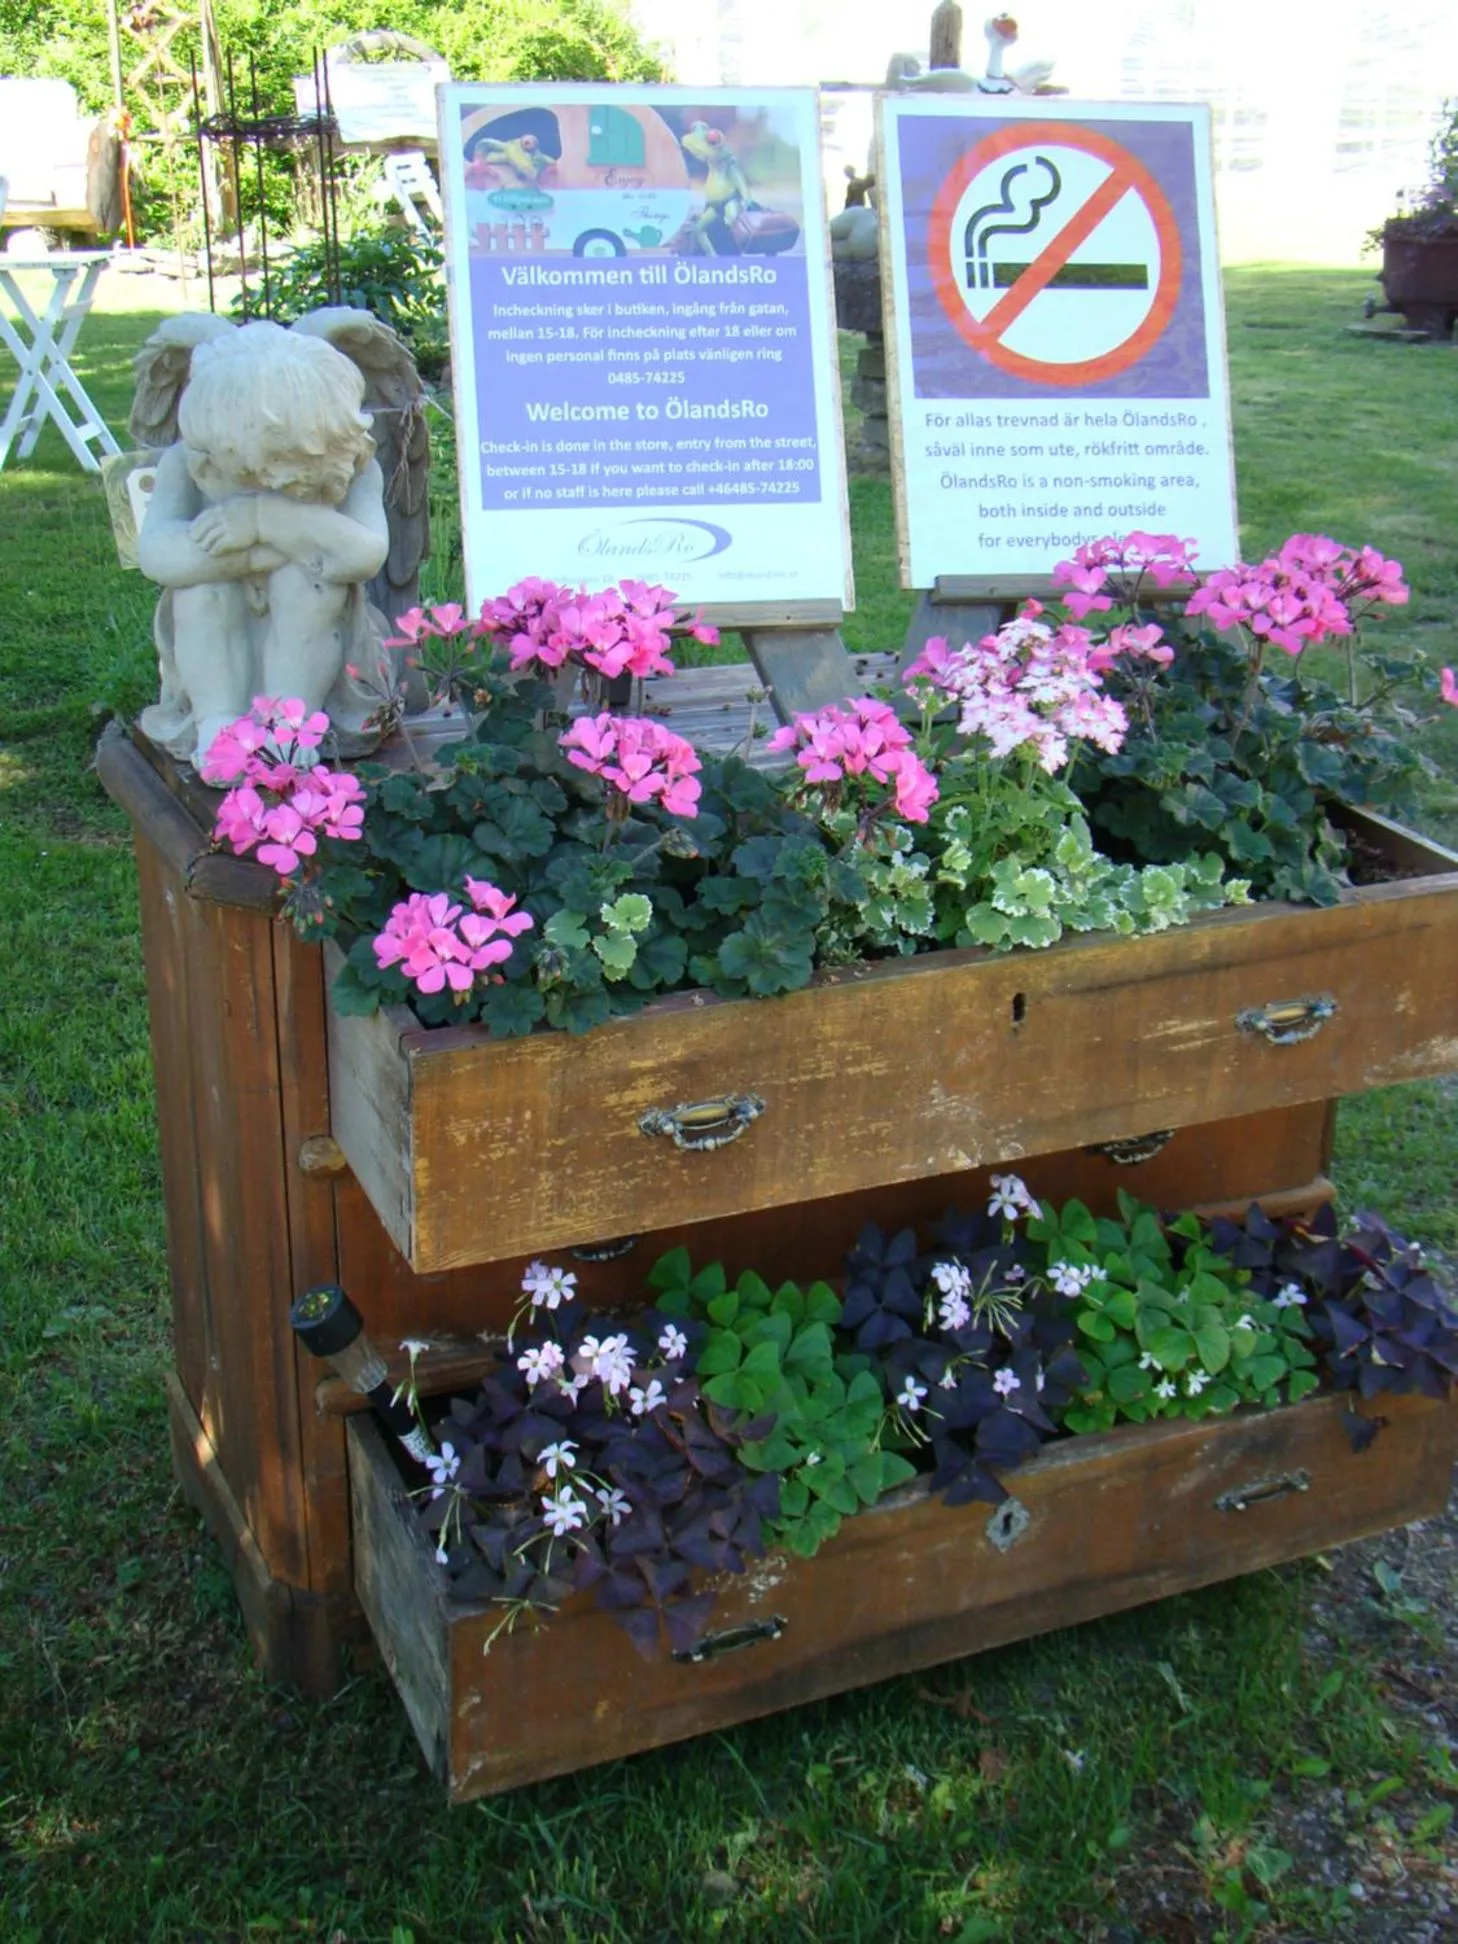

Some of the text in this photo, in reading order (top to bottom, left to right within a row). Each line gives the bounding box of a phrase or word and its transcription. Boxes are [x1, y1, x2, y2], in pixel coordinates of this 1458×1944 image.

[501, 261, 777, 286] Välkommen till ÖlandsRo
[493, 302, 789, 319] Incheckning sker i butiken, ingång från gatan,
[487, 326, 534, 340] mellan
[583, 326, 605, 339] För
[607, 325, 687, 340] incheckning
[689, 326, 720, 339] efter
[724, 325, 740, 338] 18
[743, 325, 772, 338] eller
[775, 326, 797, 338] om
[506, 347, 783, 365] ingen personal finns på plats vänligen ring
[607, 371, 686, 384] 0485-74225
[525, 396, 769, 421] Welcome to ÖlandsRo
[925, 412, 950, 427] För
[956, 412, 992, 427] allas
[996, 412, 1059, 427] trevnad
[1064, 412, 1080, 427] är
[1084, 412, 1118, 426] hela
[1122, 409, 1198, 427] ÖlandsRo
[480, 441, 539, 453] Check-in
[542, 441, 553, 452] is
[556, 440, 591, 453] done
[593, 439, 606, 452] in
[609, 438, 632, 451] the
[635, 439, 673, 452] store,
[676, 439, 712, 452] entry
[715, 437, 746, 450] from
[749, 436, 772, 449] the
[925, 440, 1210, 458] såväl inne som ute, rökfritt område.
[486, 464, 546, 477] between
[550, 463, 587, 475] 15-18
[602, 463, 628, 477] you
[630, 462, 665, 475] want
[668, 461, 683, 473] to
[686, 460, 740, 473] check-in
[744, 459, 775, 472] after
[779, 458, 814, 471] 18:00
[940, 471, 1200, 491] ÖlandsRo is a non-smoking area,
[504, 481, 800, 500] or if no staff is here please call +46485-74225
[978, 501, 1166, 518] both inside and outside
[978, 532, 1002, 548] for
